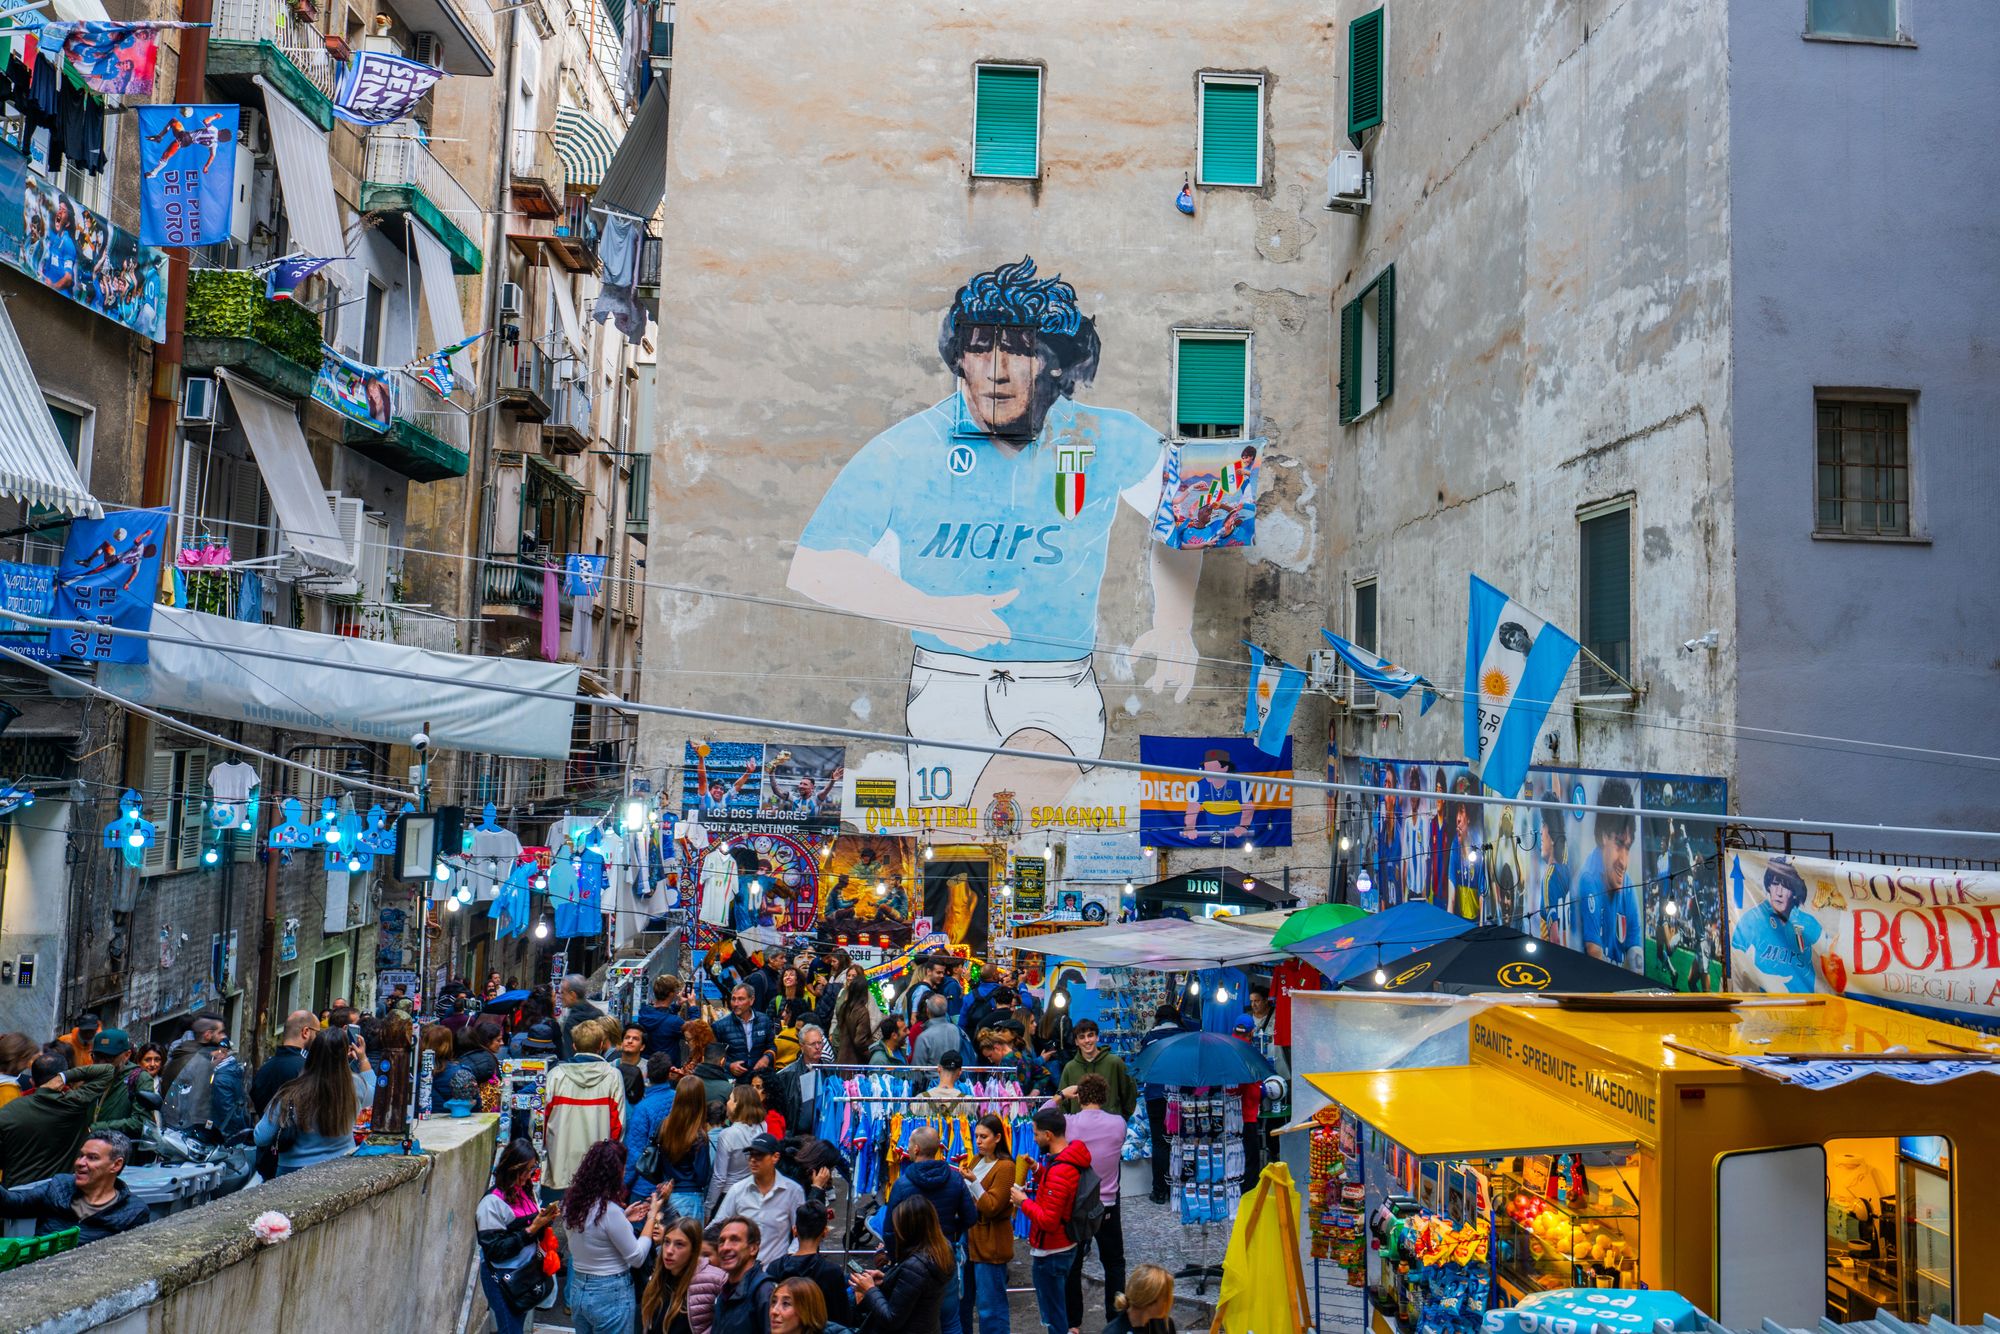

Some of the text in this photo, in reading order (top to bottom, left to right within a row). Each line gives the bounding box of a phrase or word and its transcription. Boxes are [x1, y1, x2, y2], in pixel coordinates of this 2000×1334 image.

[164, 170, 184, 244] DE ORO
[185, 169, 200, 242] EL PIBE
[953, 450, 971, 472] N
[918, 523, 1064, 566] Mars
[74, 586, 92, 610] DE
[95, 586, 117, 658] EL PBE
[1484, 713, 1501, 733] DE
[917, 766, 953, 801] 10
[1140, 779, 1292, 803] DIEGO VIVE
[707, 807, 808, 821] LOS DOS MEJORES
[865, 806, 1127, 832] QUARTIERI SPAGNOLI
[703, 822, 729, 832] SON
[1761, 945, 1804, 968] Mars
[1474, 1024, 1512, 1059] GRANITE
[1522, 1044, 1577, 1088] SPREMUTE
[1585, 1071, 1656, 1124] MACEDONIE
